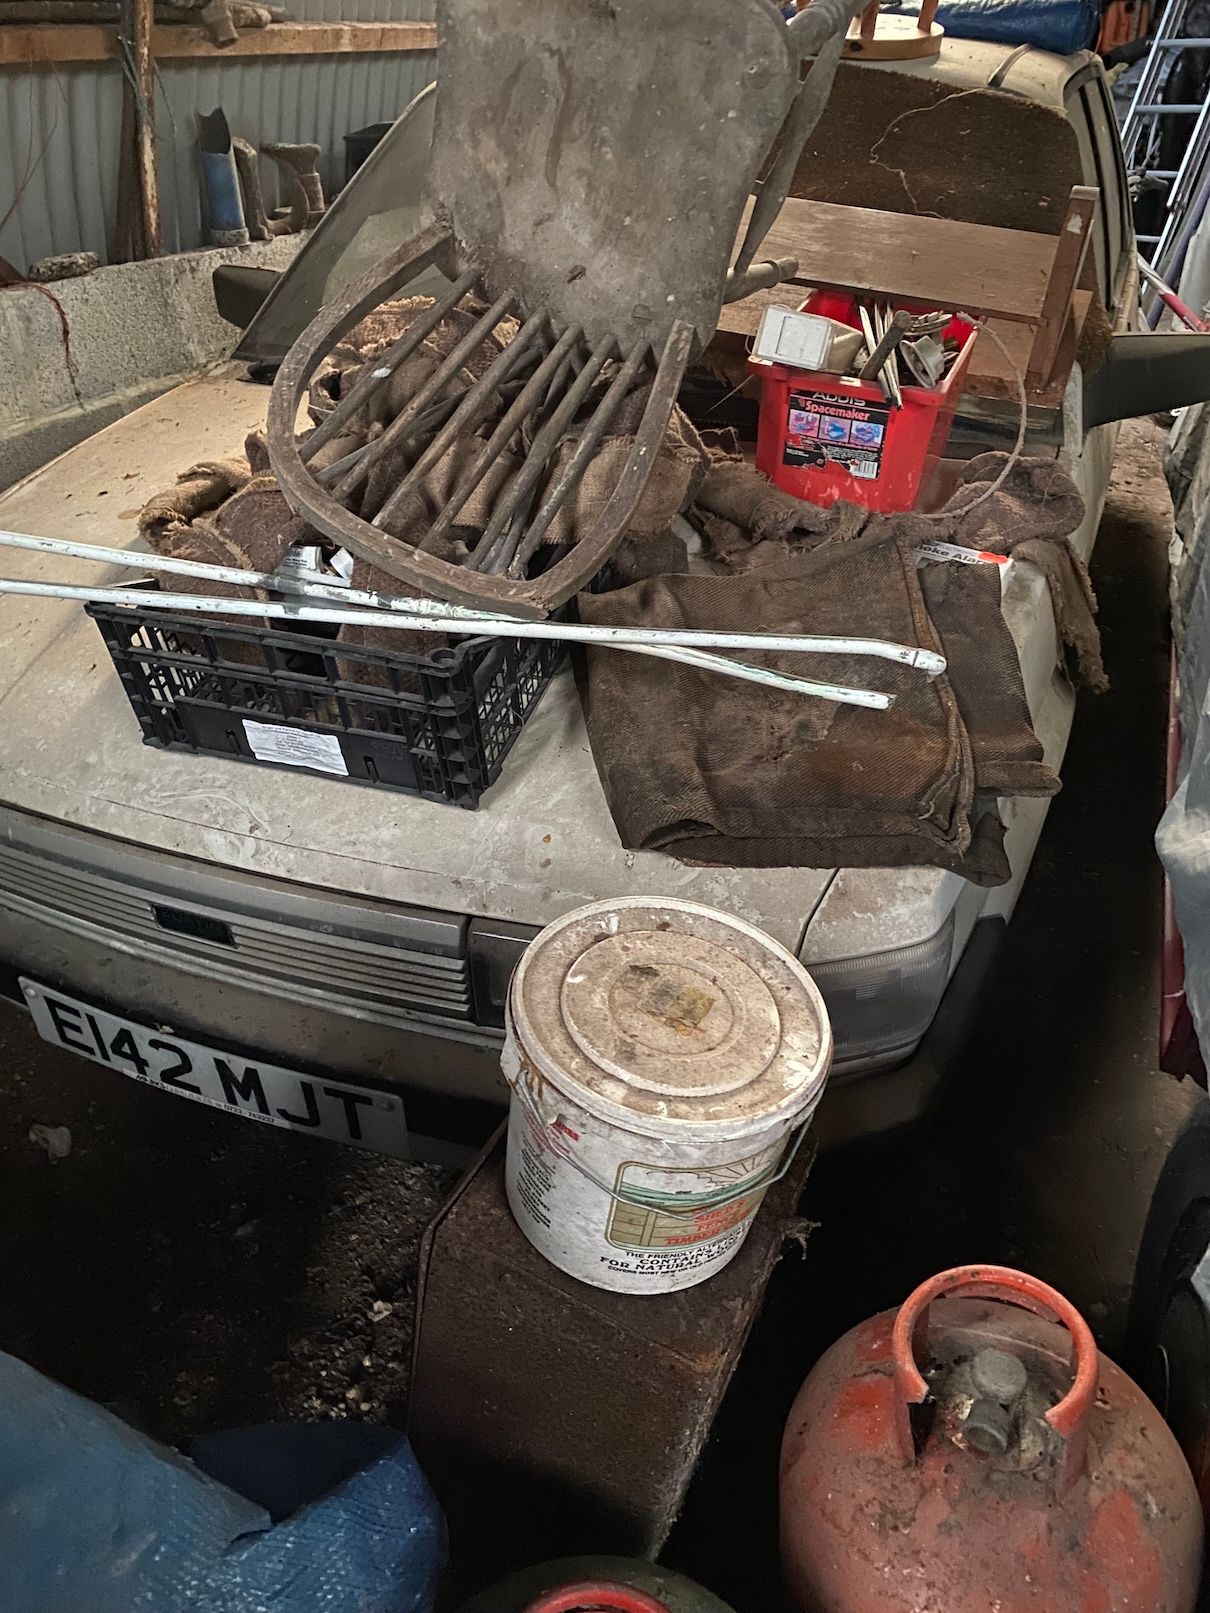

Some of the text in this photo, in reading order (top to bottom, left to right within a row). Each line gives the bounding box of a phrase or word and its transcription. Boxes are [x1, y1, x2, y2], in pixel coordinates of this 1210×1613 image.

[805, 400, 870, 421] Spacemaker
[918, 545, 950, 556] oke
[43, 994, 374, 1140] E142 MJT
[626, 1251, 643, 1259] THE
[649, 1250, 693, 1259] FRIENDLY
[639, 1247, 712, 1265] CONTAINS
[600, 1256, 630, 1268] FOR
[636, 1258, 701, 1271] NATURAL
[608, 1266, 637, 1274] COVERS
